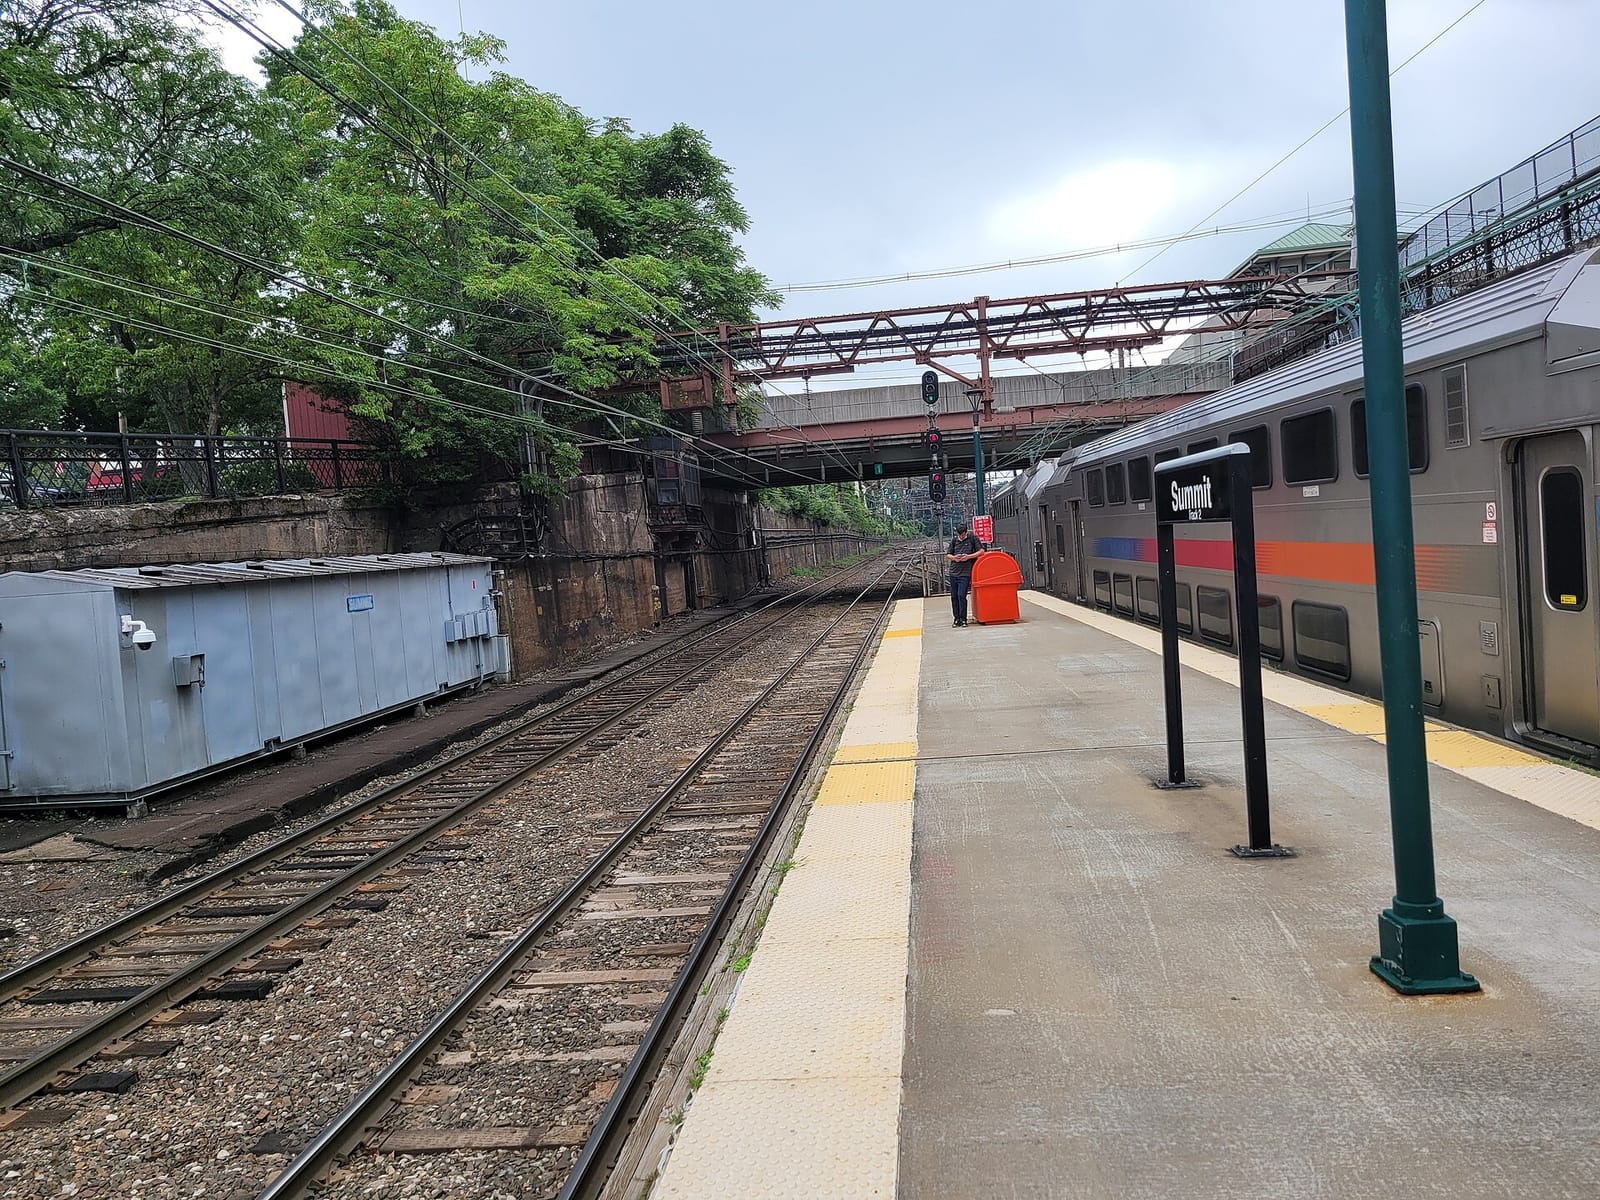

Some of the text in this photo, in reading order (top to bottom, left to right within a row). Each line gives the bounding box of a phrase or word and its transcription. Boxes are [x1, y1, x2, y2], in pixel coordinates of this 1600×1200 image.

[1171, 475, 1212, 512] Summit
[1188, 509, 1202, 520] Track 2
